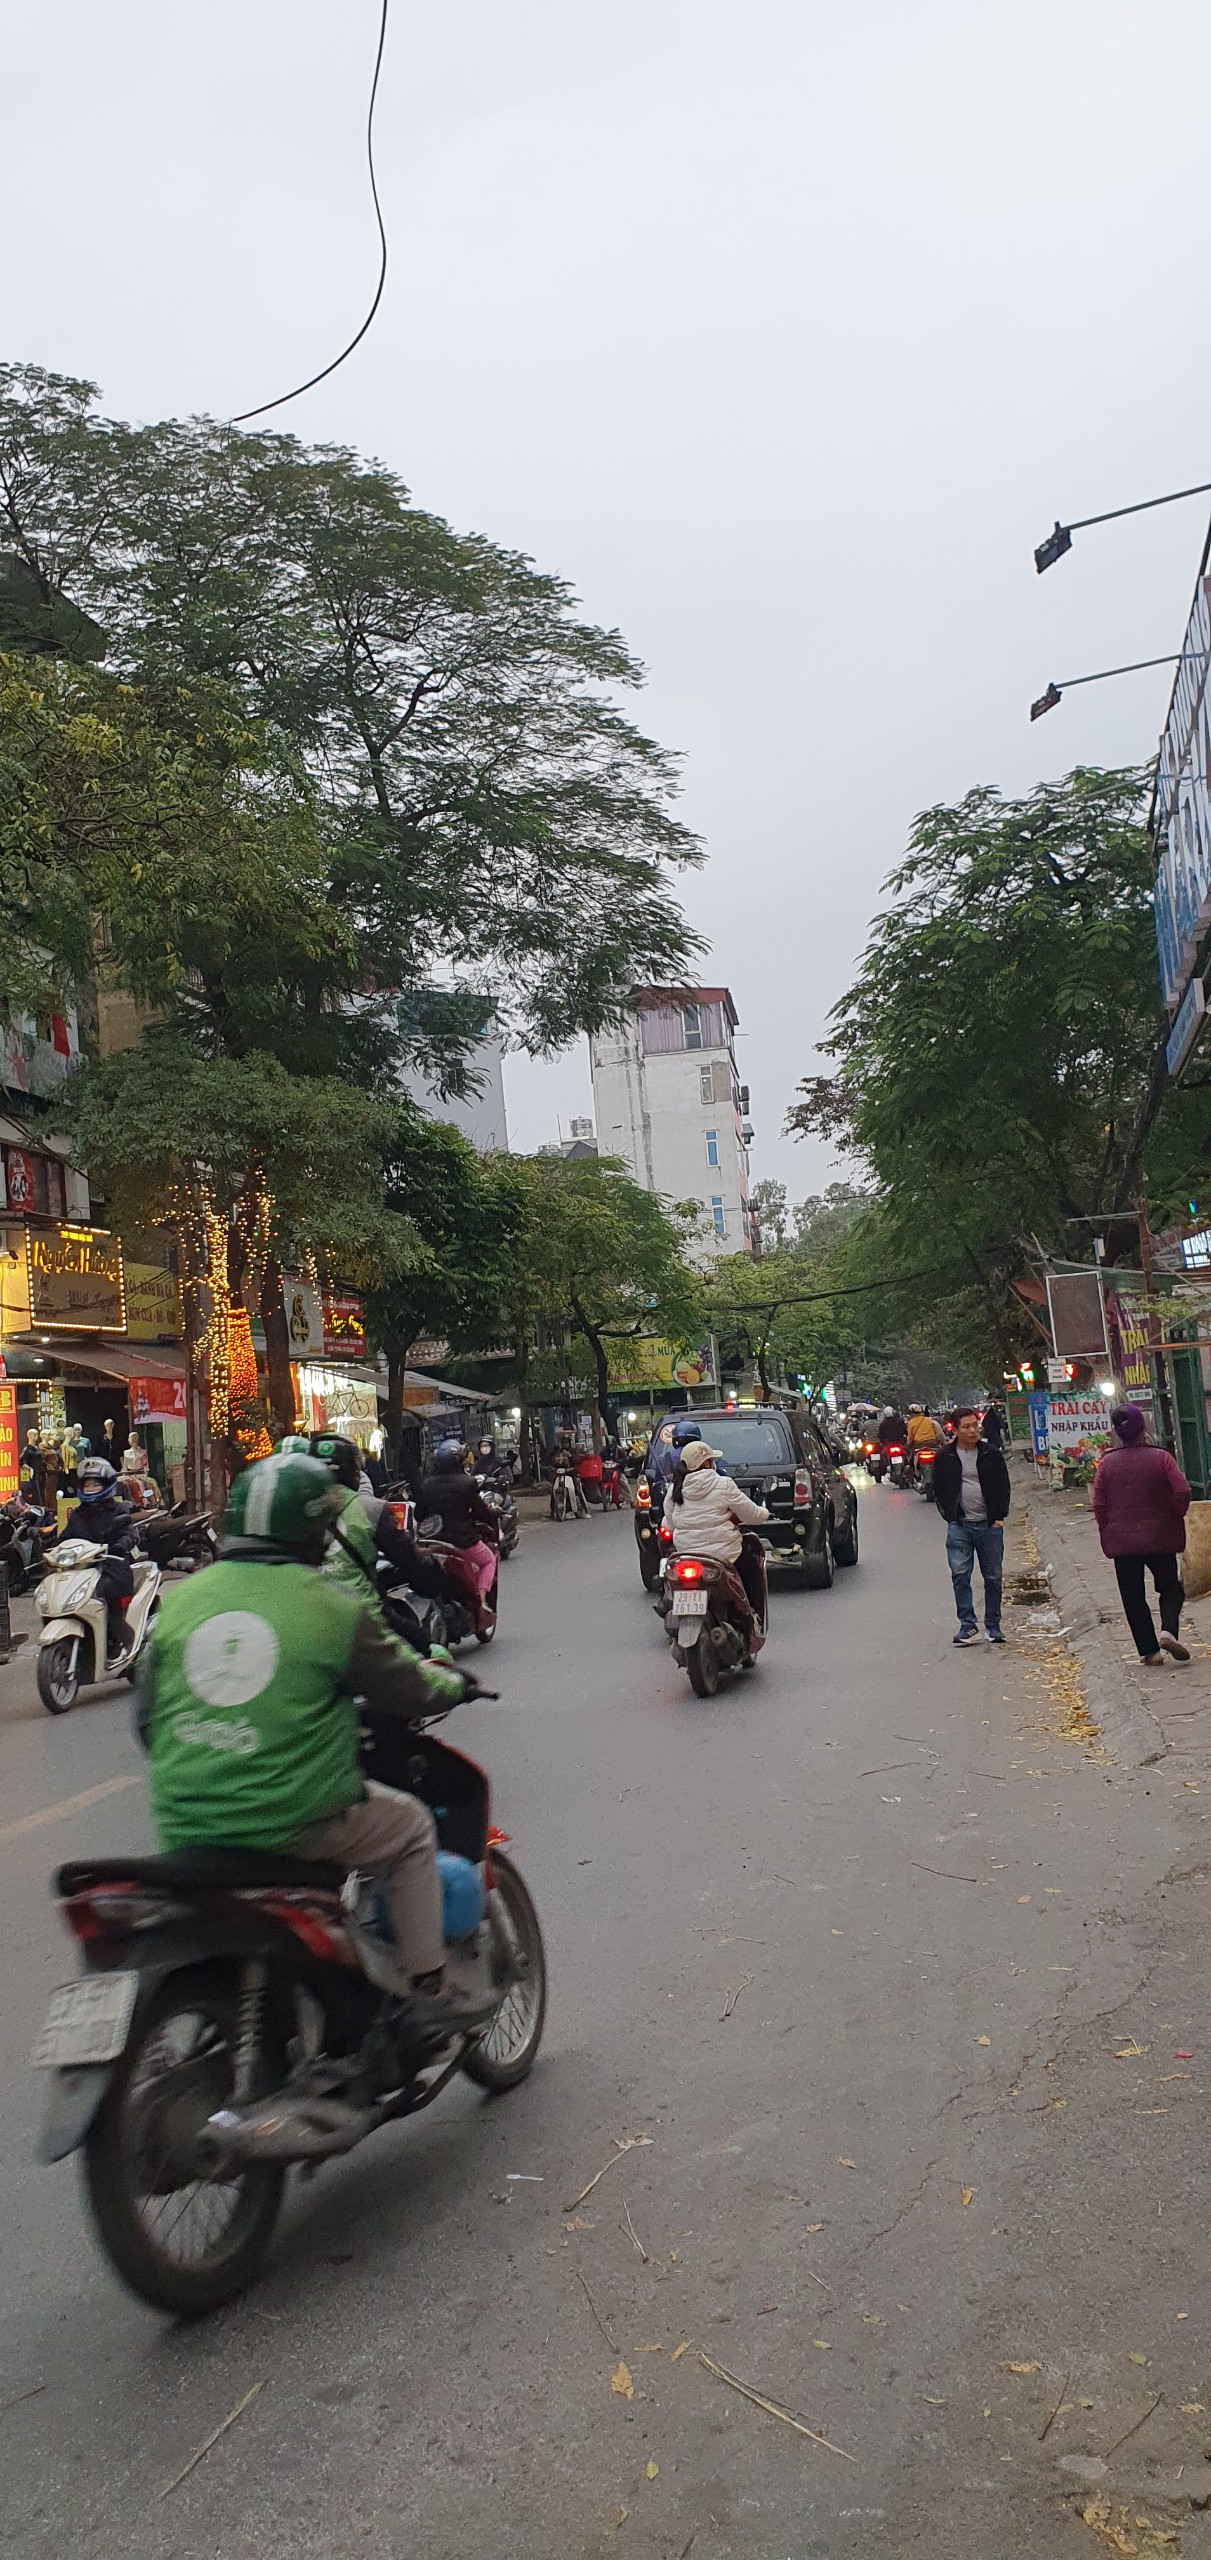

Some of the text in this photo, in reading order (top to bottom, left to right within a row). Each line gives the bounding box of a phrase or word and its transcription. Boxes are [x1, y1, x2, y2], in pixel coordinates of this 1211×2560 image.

[1050, 1397, 1106, 1415] TRÁI CÂY
[1051, 1416, 1108, 1434] NHẬP KHẨU
